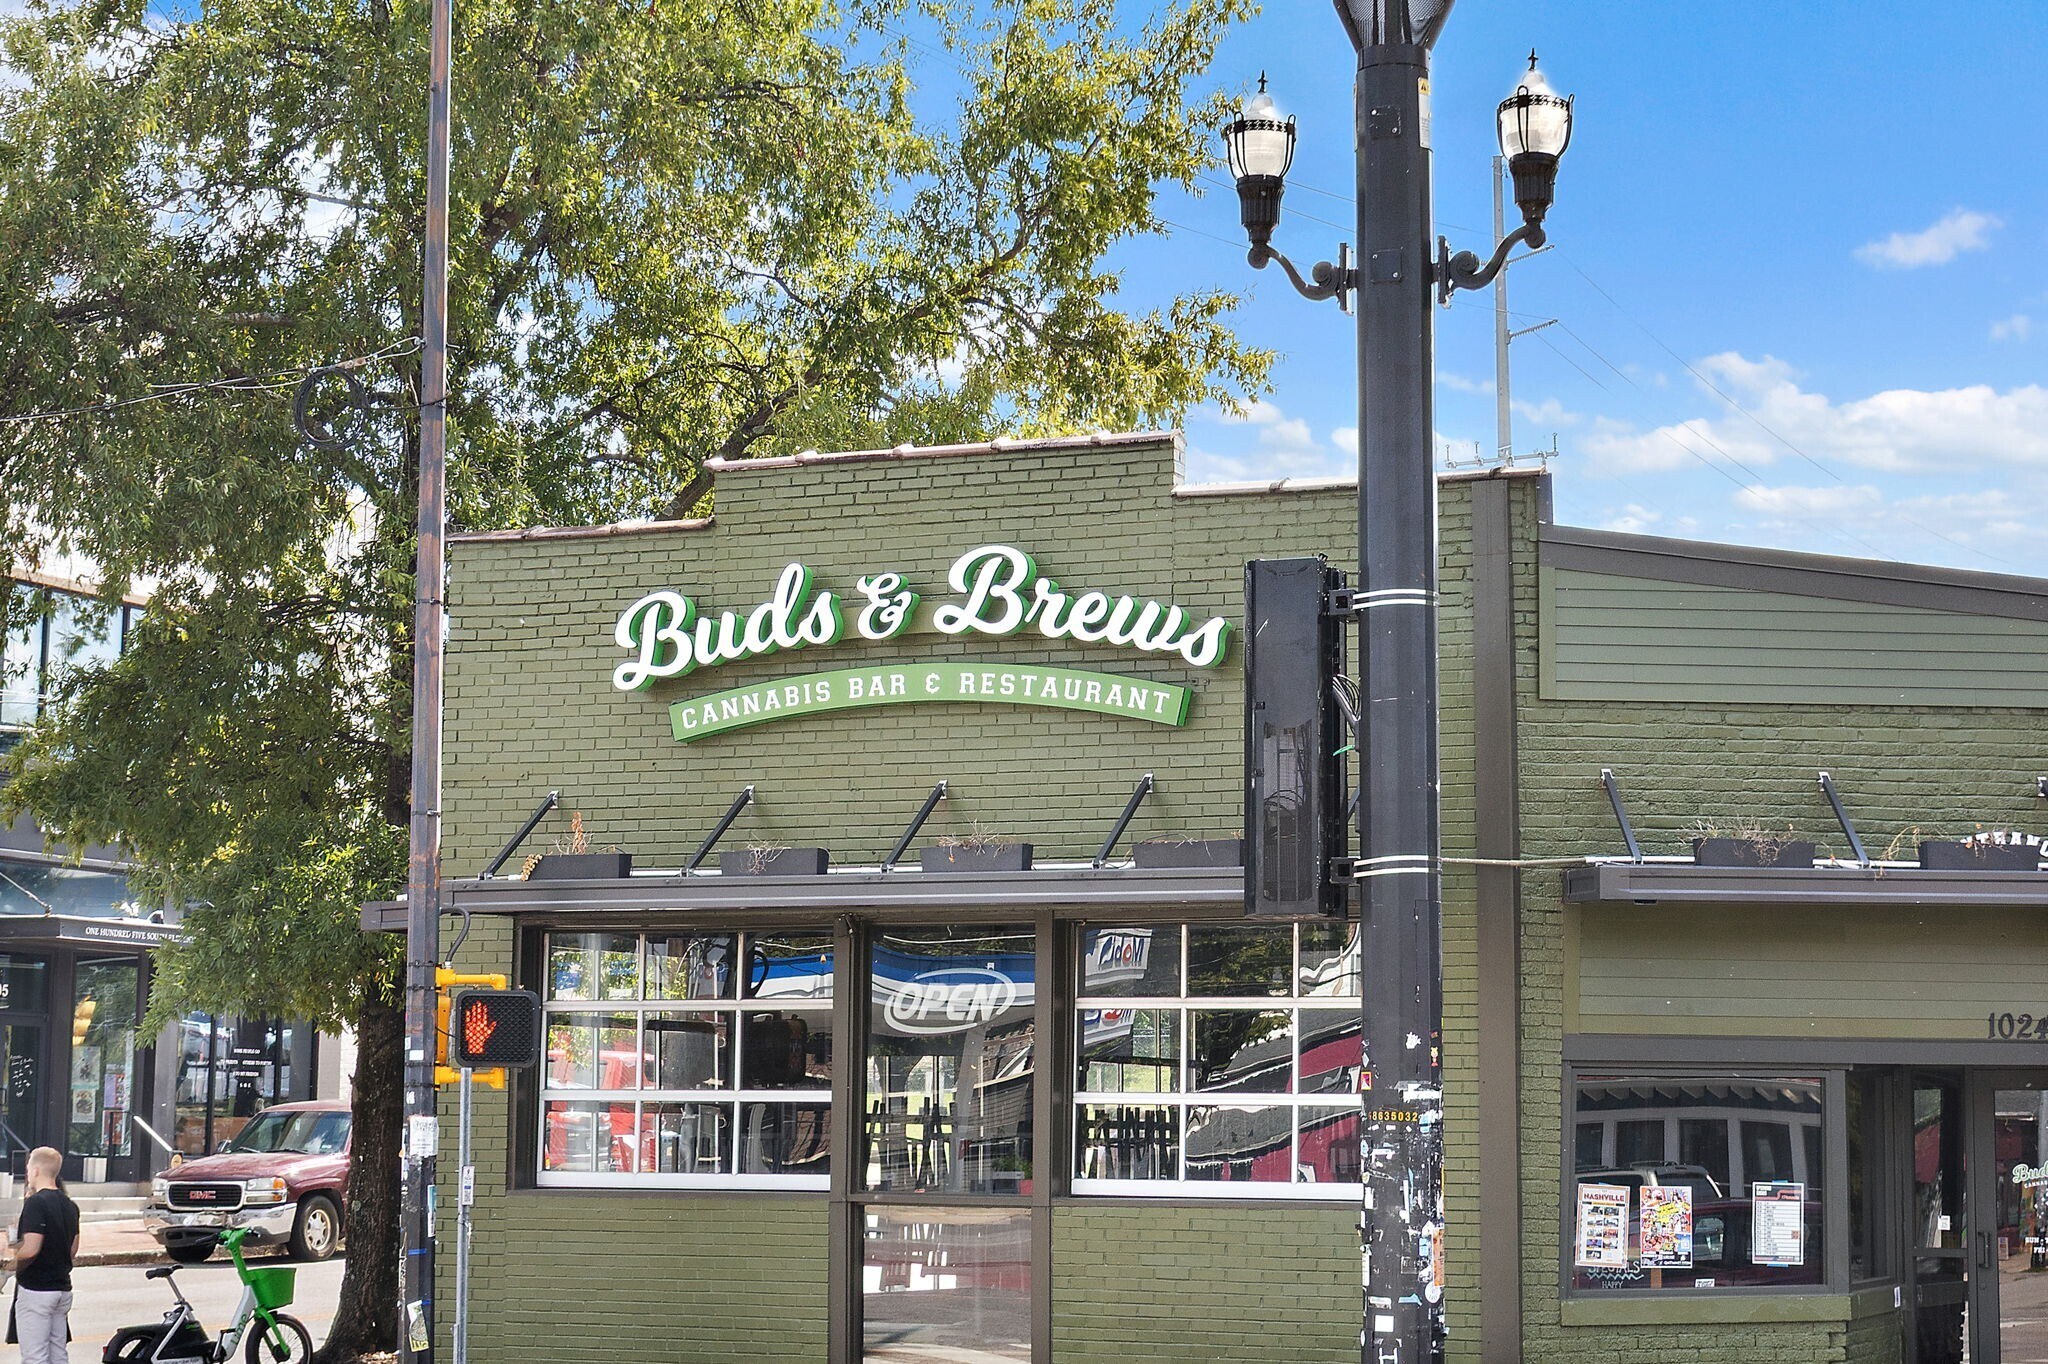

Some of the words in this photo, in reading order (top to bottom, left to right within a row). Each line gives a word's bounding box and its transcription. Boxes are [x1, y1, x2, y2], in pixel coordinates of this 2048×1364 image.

[613, 562, 843, 692] Buds
[857, 572, 920, 640] &
[933, 545, 1231, 667] Brews
[681, 680, 831, 730] CANNABIS
[848, 673, 906, 700] BAR
[925, 672, 941, 695] &
[959, 672, 1171, 714] RESTAURANT
[85, 926, 100, 936] ONE
[132, 931, 146, 940] FIVE
[893, 982, 1001, 1021] OPEN
[1988, 1012, 2048, 1040] 1024
[189, 1190, 216, 1200] GMC
[1583, 1193, 1625, 1202] NASHVILLE
